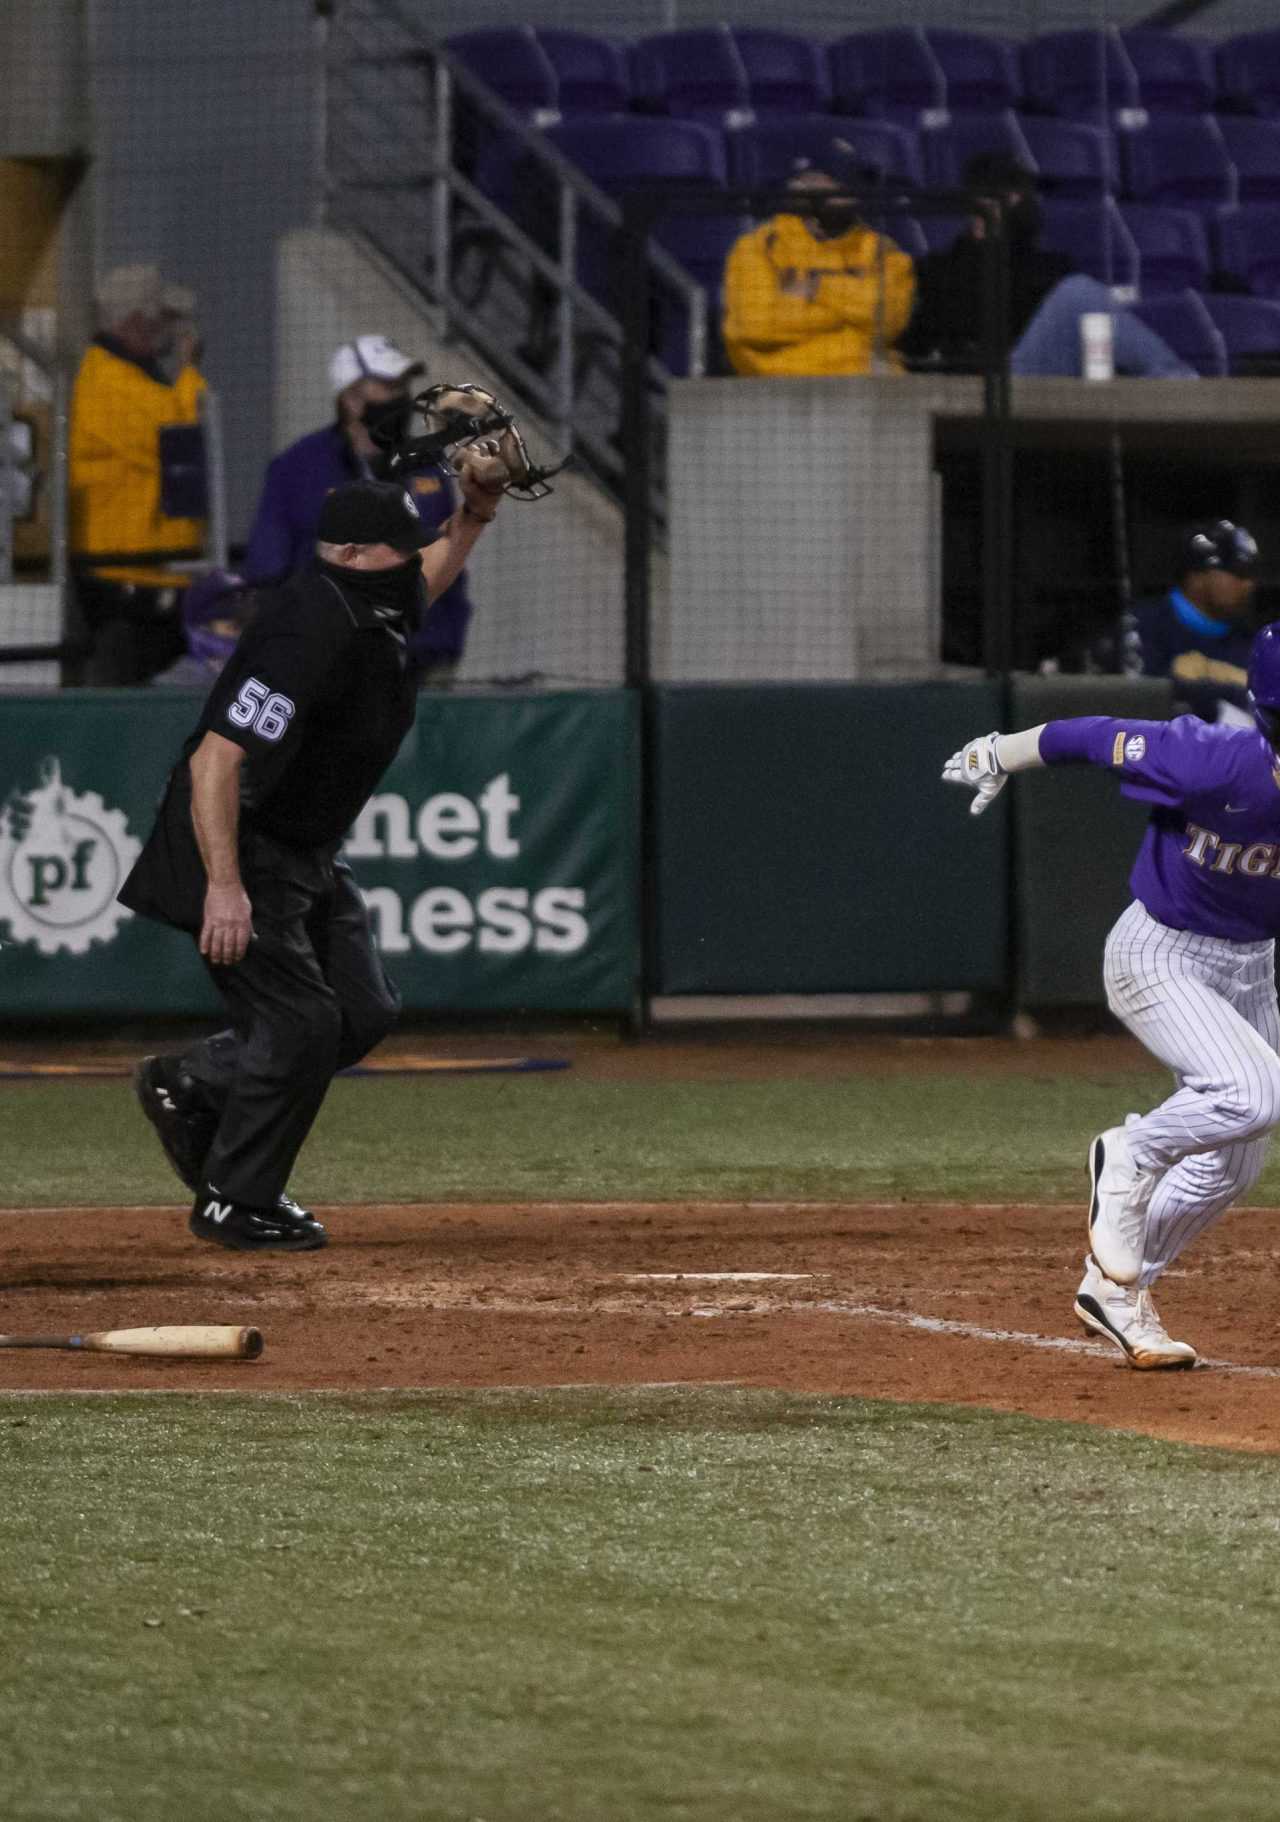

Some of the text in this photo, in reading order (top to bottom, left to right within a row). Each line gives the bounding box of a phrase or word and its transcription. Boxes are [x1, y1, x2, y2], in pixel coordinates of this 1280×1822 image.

[228, 676, 296, 741] 56
[343, 773, 521, 859] net
[27, 838, 97, 907] pf
[362, 886, 589, 953] ness
